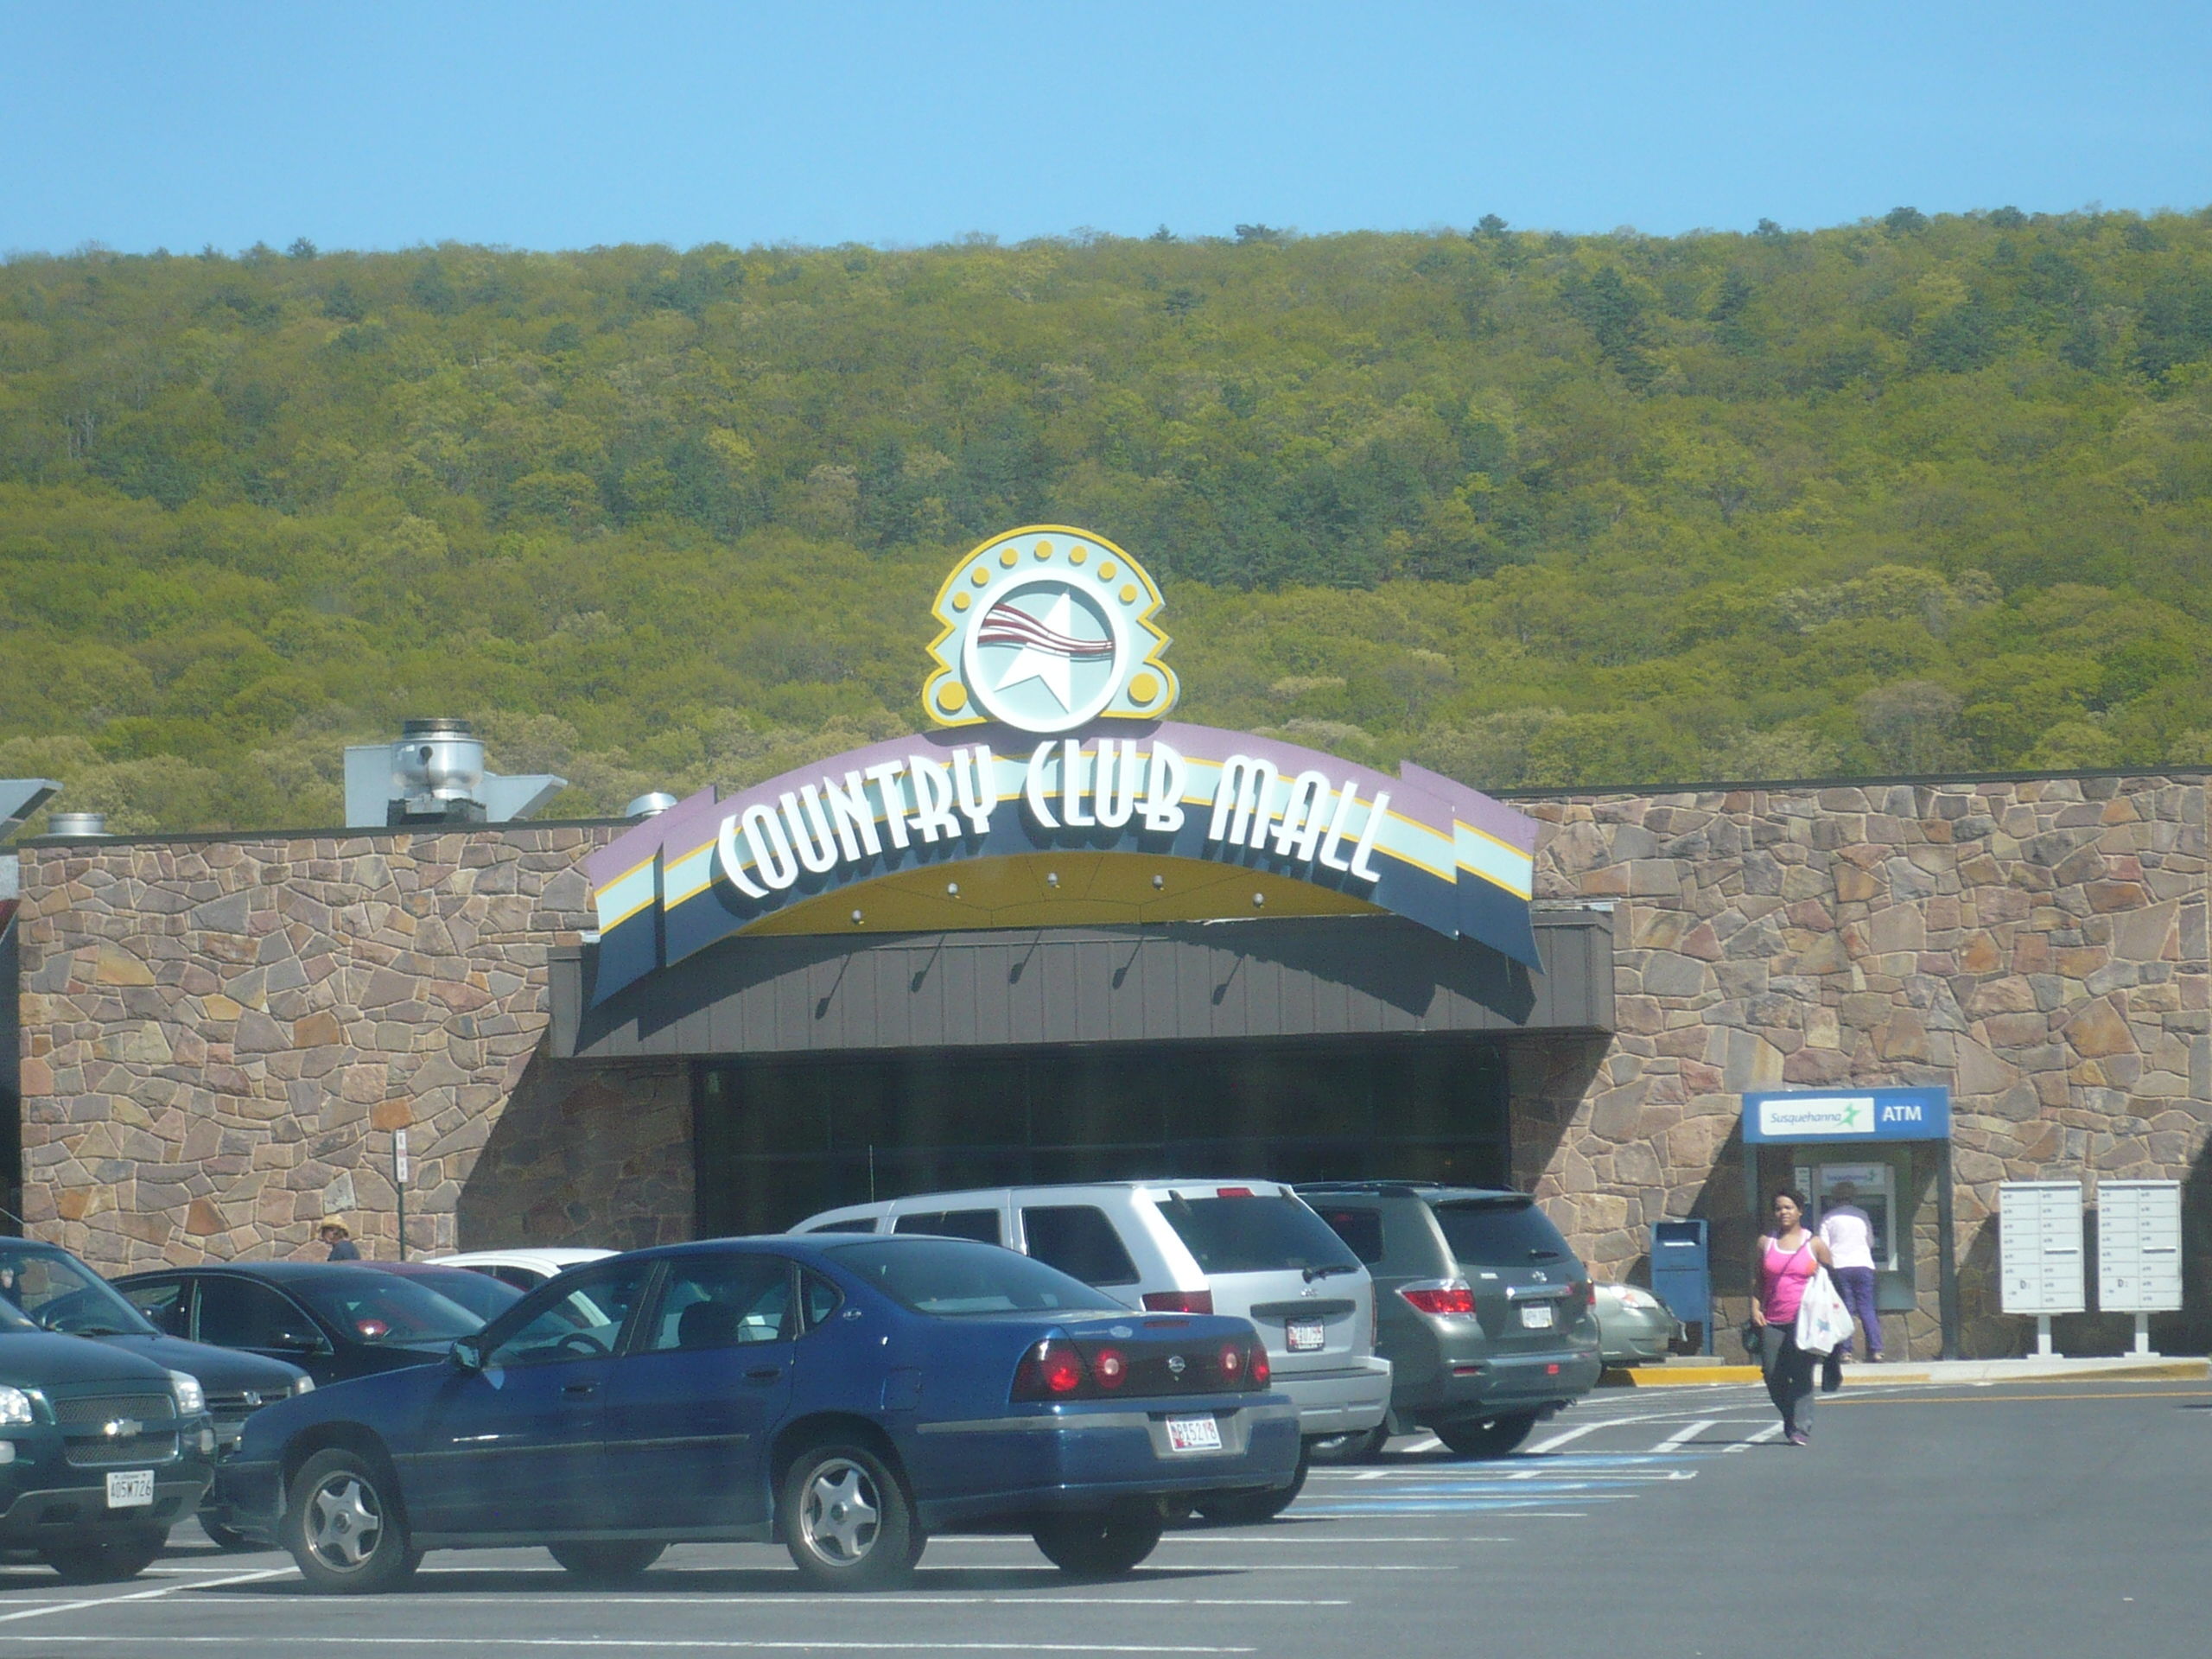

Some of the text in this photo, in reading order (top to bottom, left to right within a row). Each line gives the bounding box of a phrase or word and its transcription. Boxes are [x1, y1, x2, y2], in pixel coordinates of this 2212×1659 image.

[716, 739, 1389, 899] COUNTRY CLUB MALL
[1771, 1105, 1923, 1126] Susquehanna ATM
